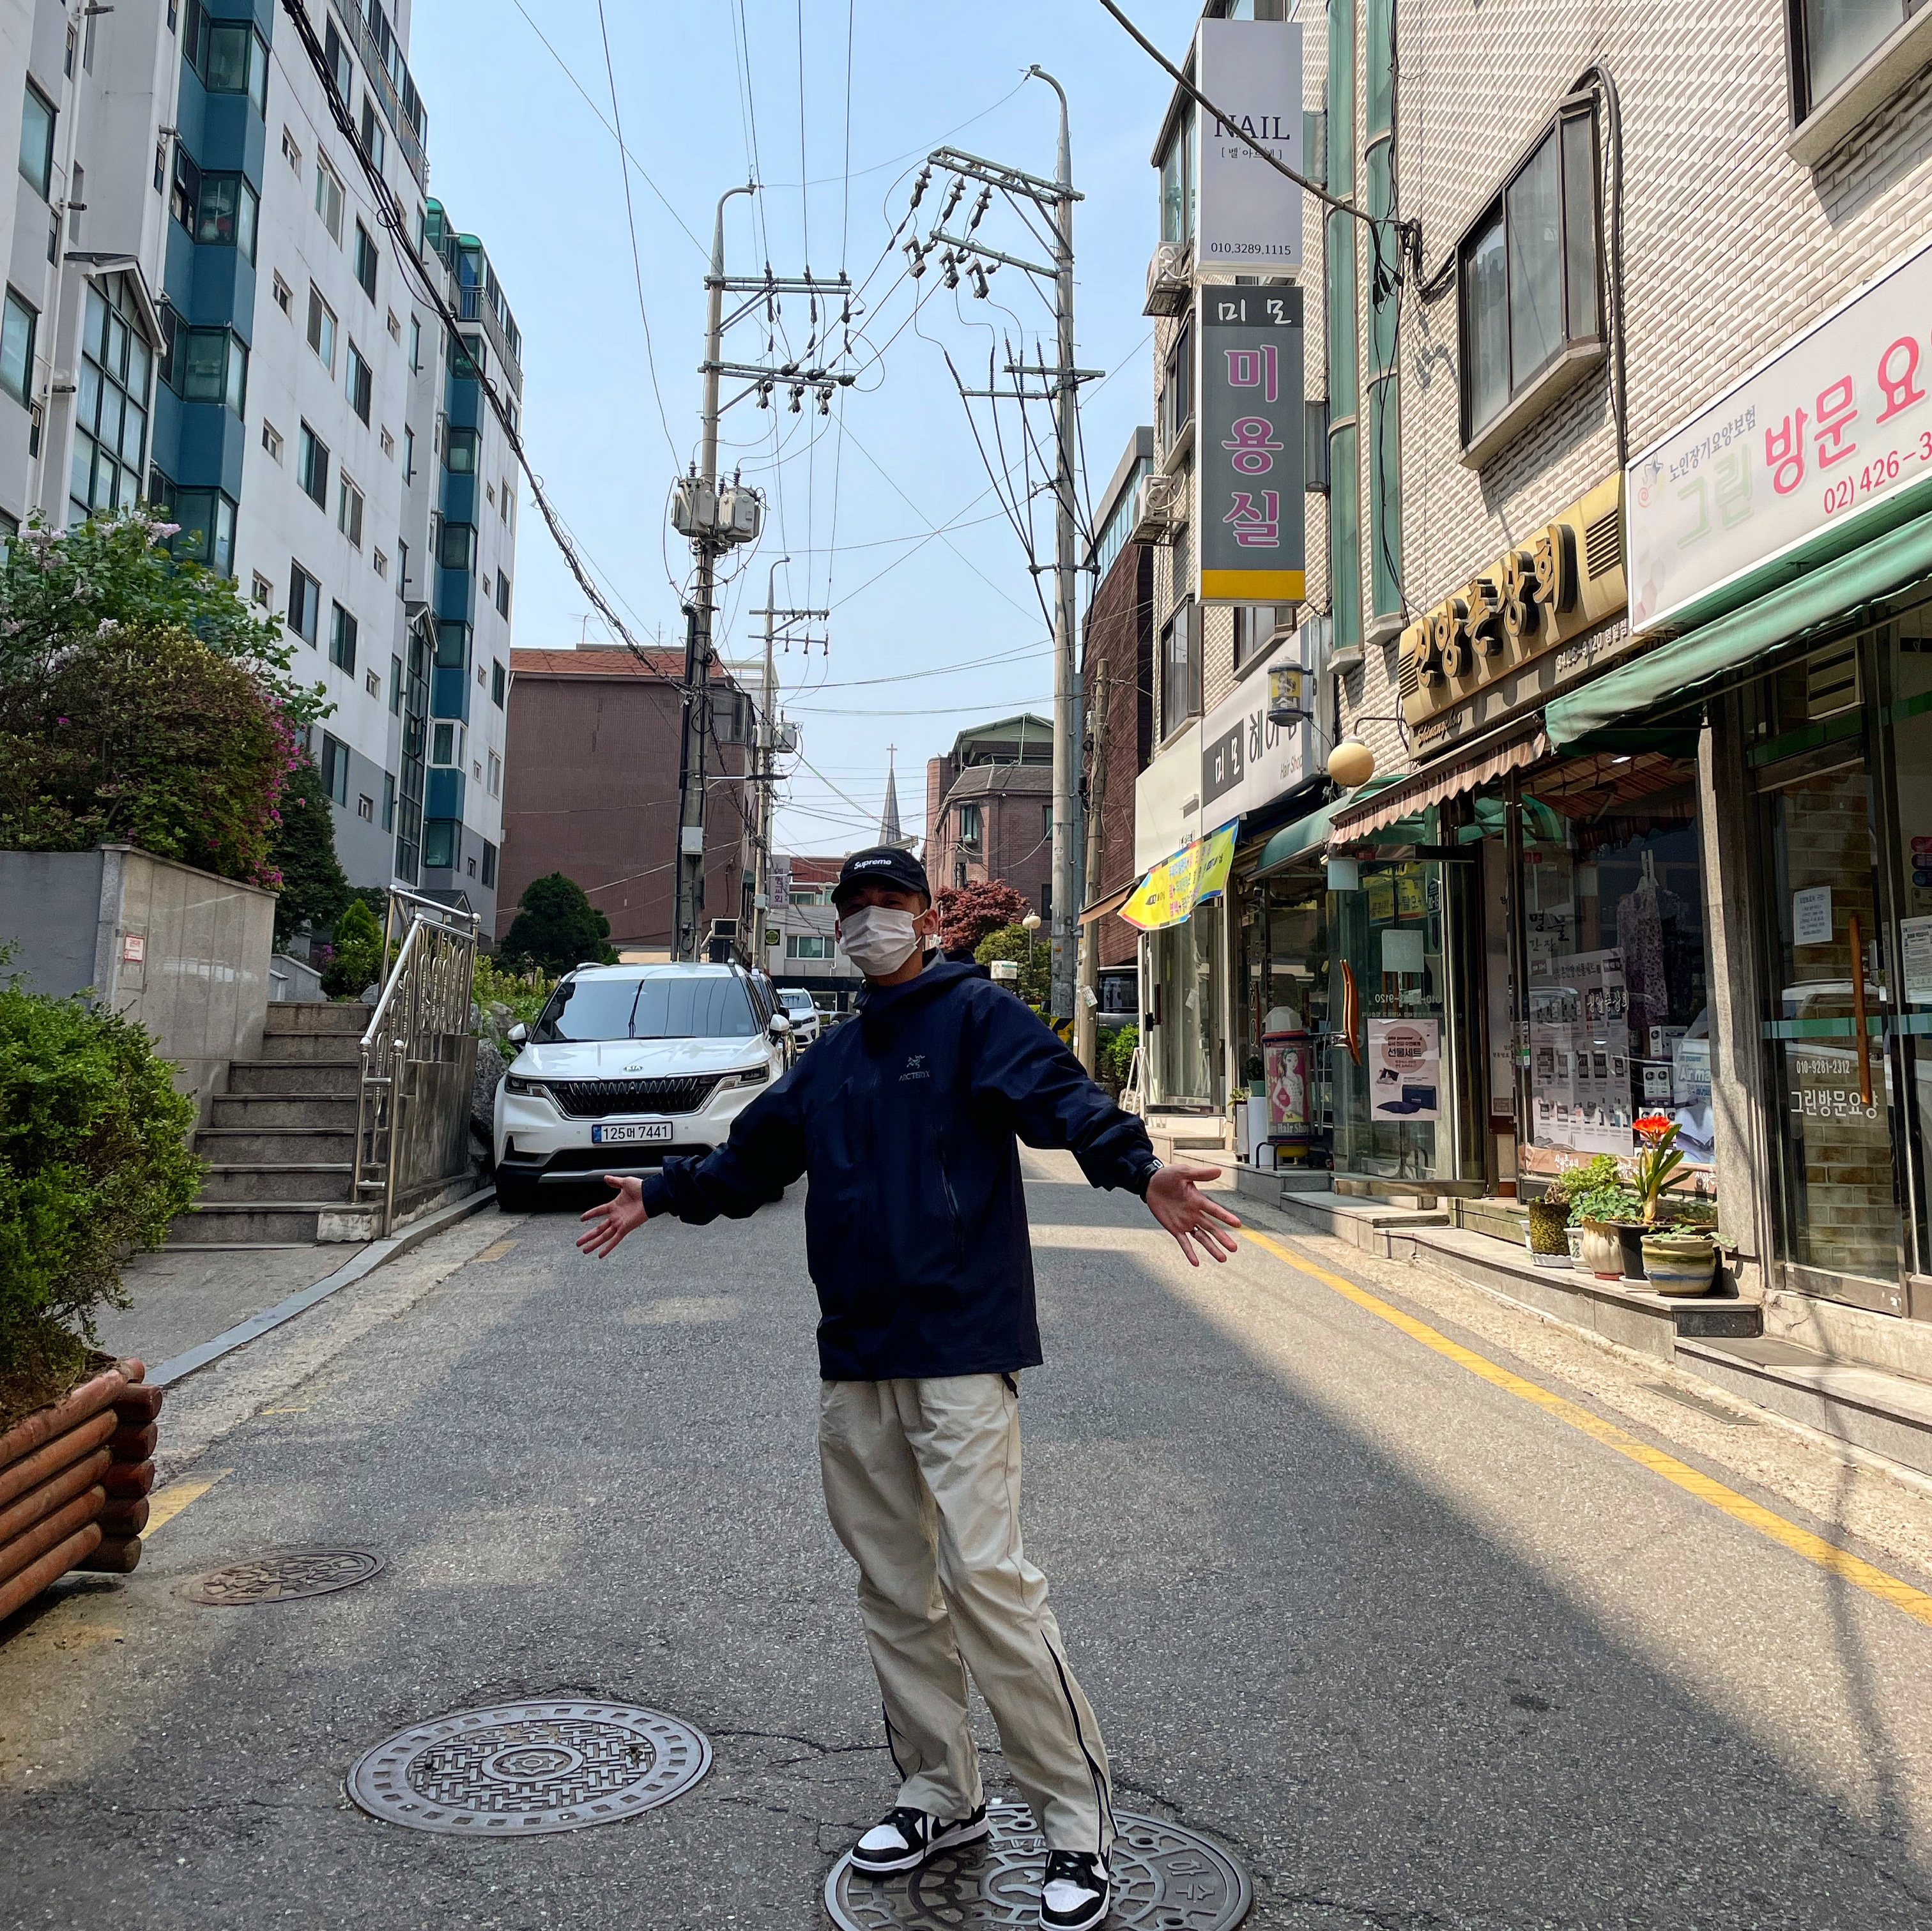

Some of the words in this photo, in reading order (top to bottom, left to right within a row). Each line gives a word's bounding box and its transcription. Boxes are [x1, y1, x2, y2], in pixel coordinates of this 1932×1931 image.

[1215, 114, 1291, 140] NAIL
[1211, 241, 1291, 255] 010.3289.1115
[1220, 344, 1284, 548] 미용실
[1669, 404, 1756, 483] 노인장기요양보험
[1676, 443, 1754, 550] 그린
[1280, 759, 1290, 780] Hair
[1290, 754, 1303, 774] Shop
[854, 859, 892, 870] Supreme
[1388, 1048, 1422, 1057] 선물세트
[1796, 1059, 1851, 1074] 010-9281-2312
[638, 1125, 667, 1139] 7441
